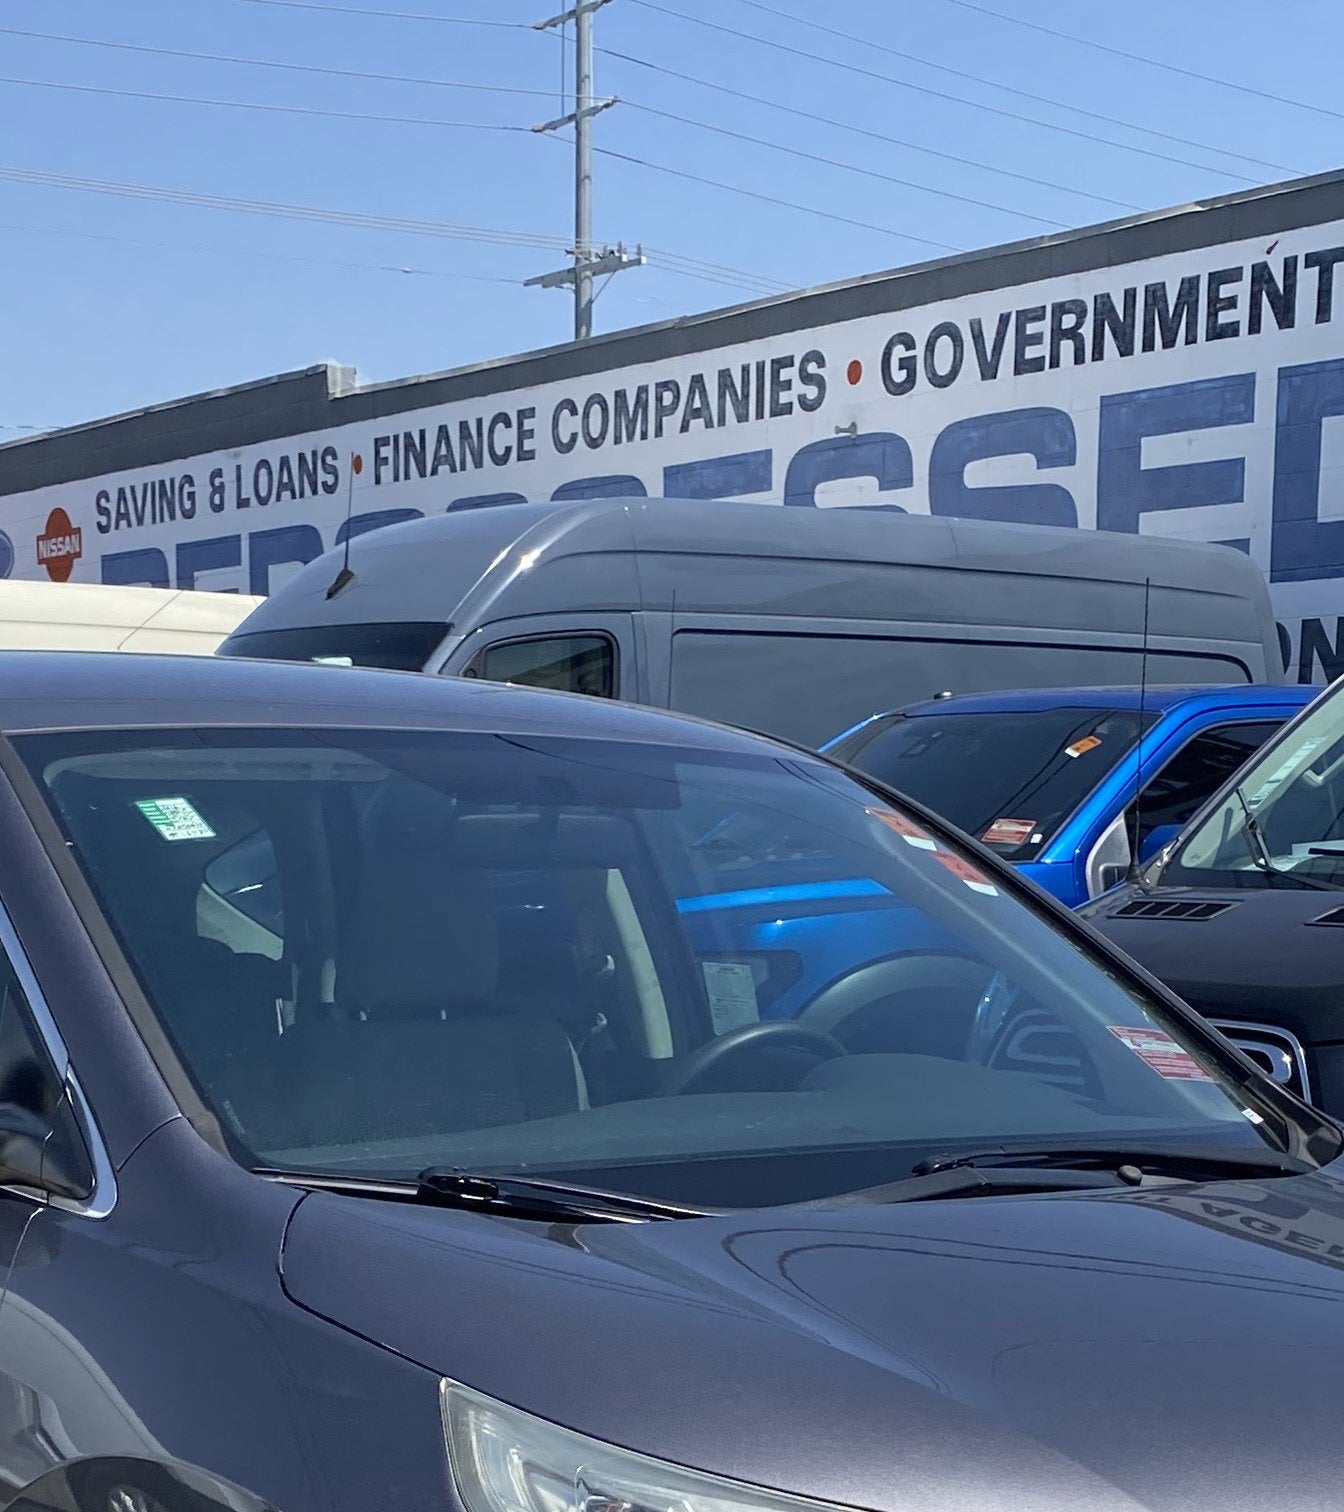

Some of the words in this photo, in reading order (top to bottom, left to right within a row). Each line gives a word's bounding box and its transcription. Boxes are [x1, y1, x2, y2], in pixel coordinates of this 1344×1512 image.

[373, 406, 536, 486] FINANCE
[551, 349, 827, 455] COMPANIES
[96, 474, 196, 535] SAVING
[209, 467, 226, 513] &
[236, 445, 339, 510] LOANS
[38, 534, 80, 559] NISSAN
